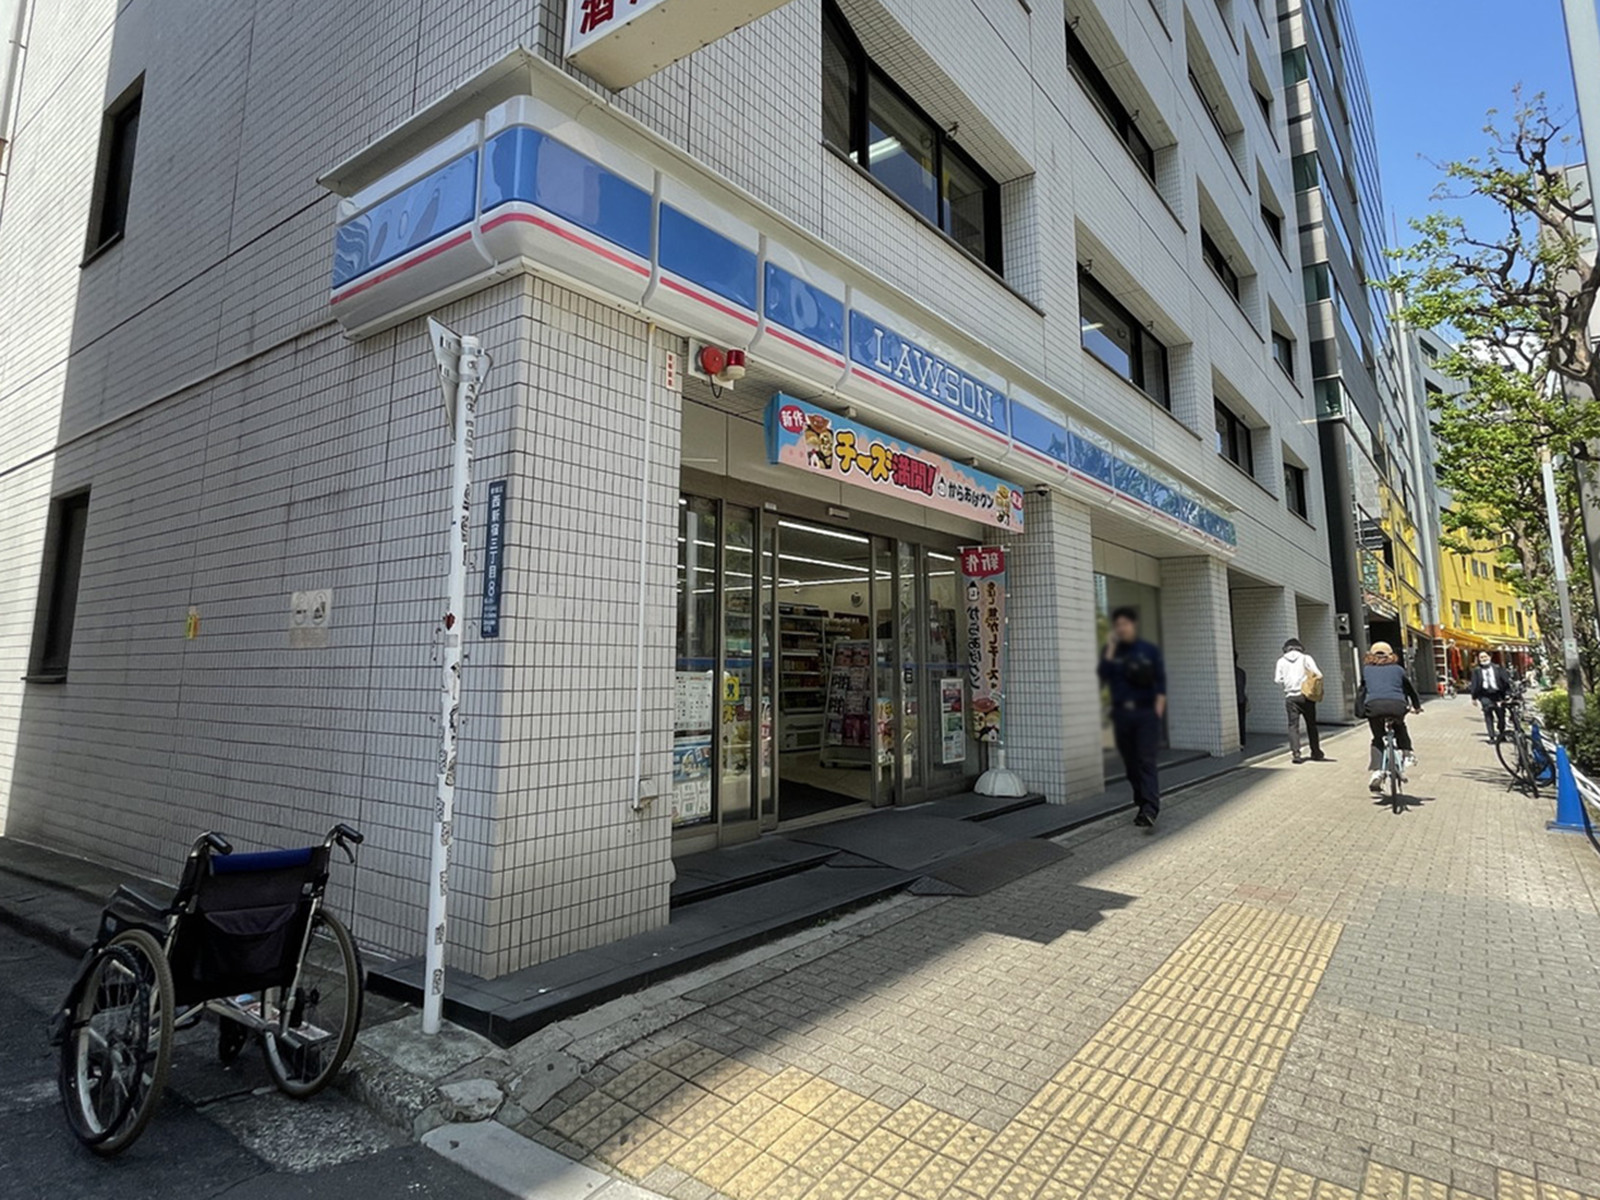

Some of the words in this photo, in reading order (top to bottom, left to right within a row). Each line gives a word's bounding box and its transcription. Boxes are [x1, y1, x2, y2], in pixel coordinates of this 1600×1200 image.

[874, 328, 993, 422] LAWSON
[781, 409, 804, 427] 新作
[948, 484, 994, 511] からあげクン
